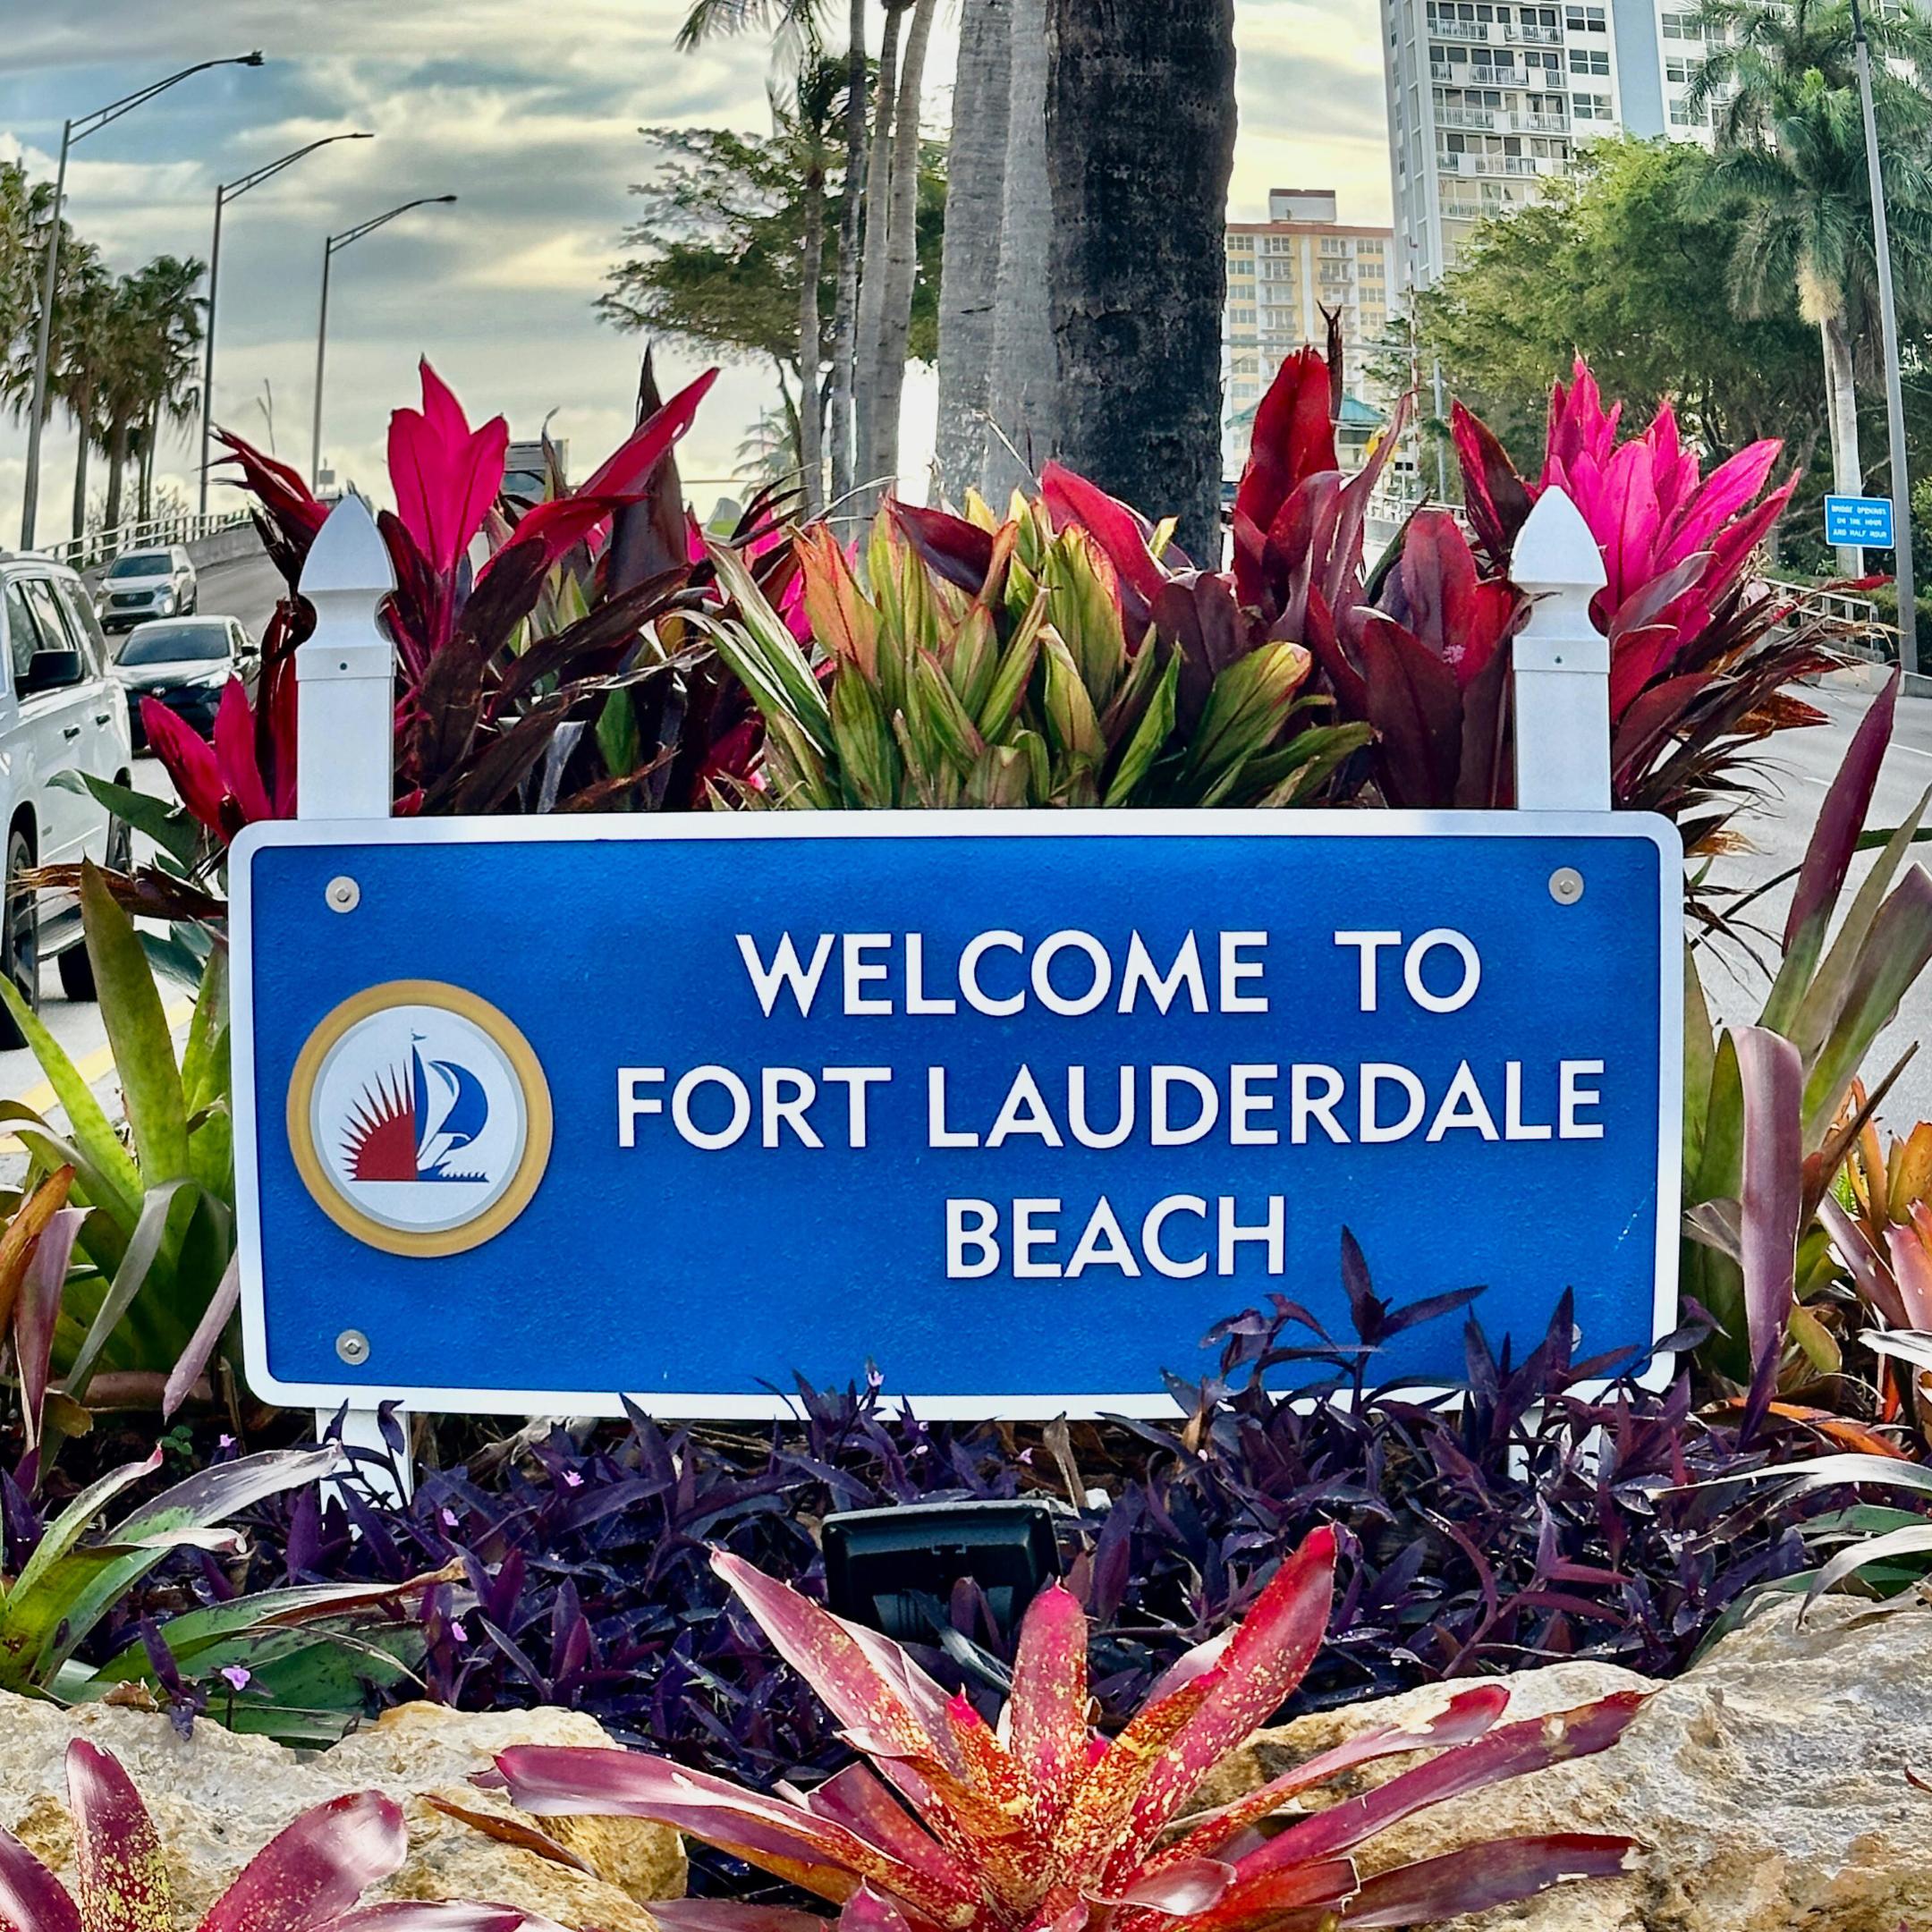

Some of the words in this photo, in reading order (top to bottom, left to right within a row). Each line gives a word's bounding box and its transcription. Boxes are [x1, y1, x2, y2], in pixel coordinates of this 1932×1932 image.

[1833, 529, 1847, 537] AND
[1849, 530, 1867, 538] HALF
[736, 929, 1268, 1017] WELCOME
[1335, 928, 1480, 1013] TO
[617, 1065, 892, 1150] FORT
[928, 1060, 1605, 1148] LAUDERDALE
[946, 1195, 1284, 1278] BEACH
